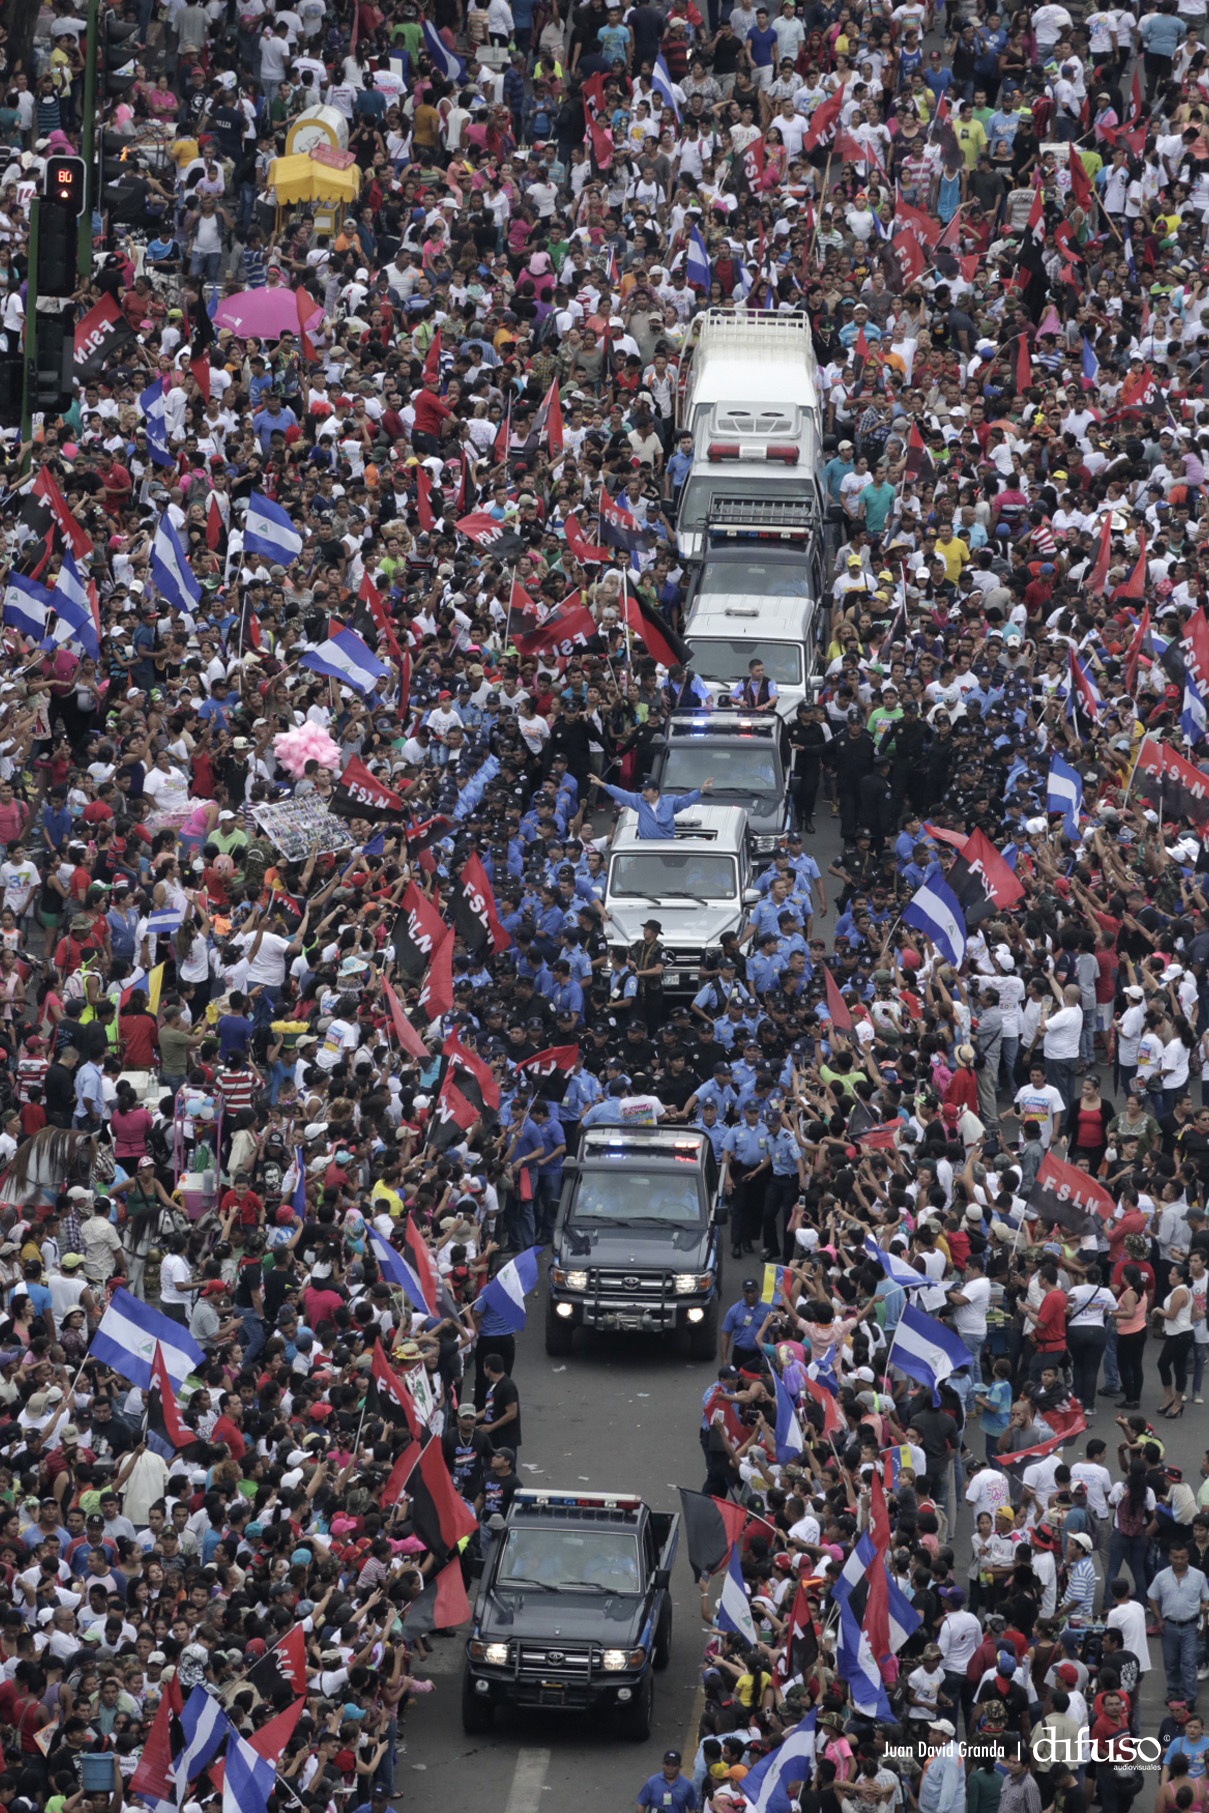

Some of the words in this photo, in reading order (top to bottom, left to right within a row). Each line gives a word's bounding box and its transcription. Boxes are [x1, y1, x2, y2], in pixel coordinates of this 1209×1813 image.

[604, 508, 643, 532] FSLN
[347, 781, 390, 809] FSLN
[9, 872, 30, 889] 37
[1042, 1175, 1098, 1216] FSLN
[1121, 1660, 1137, 1670] 2016
